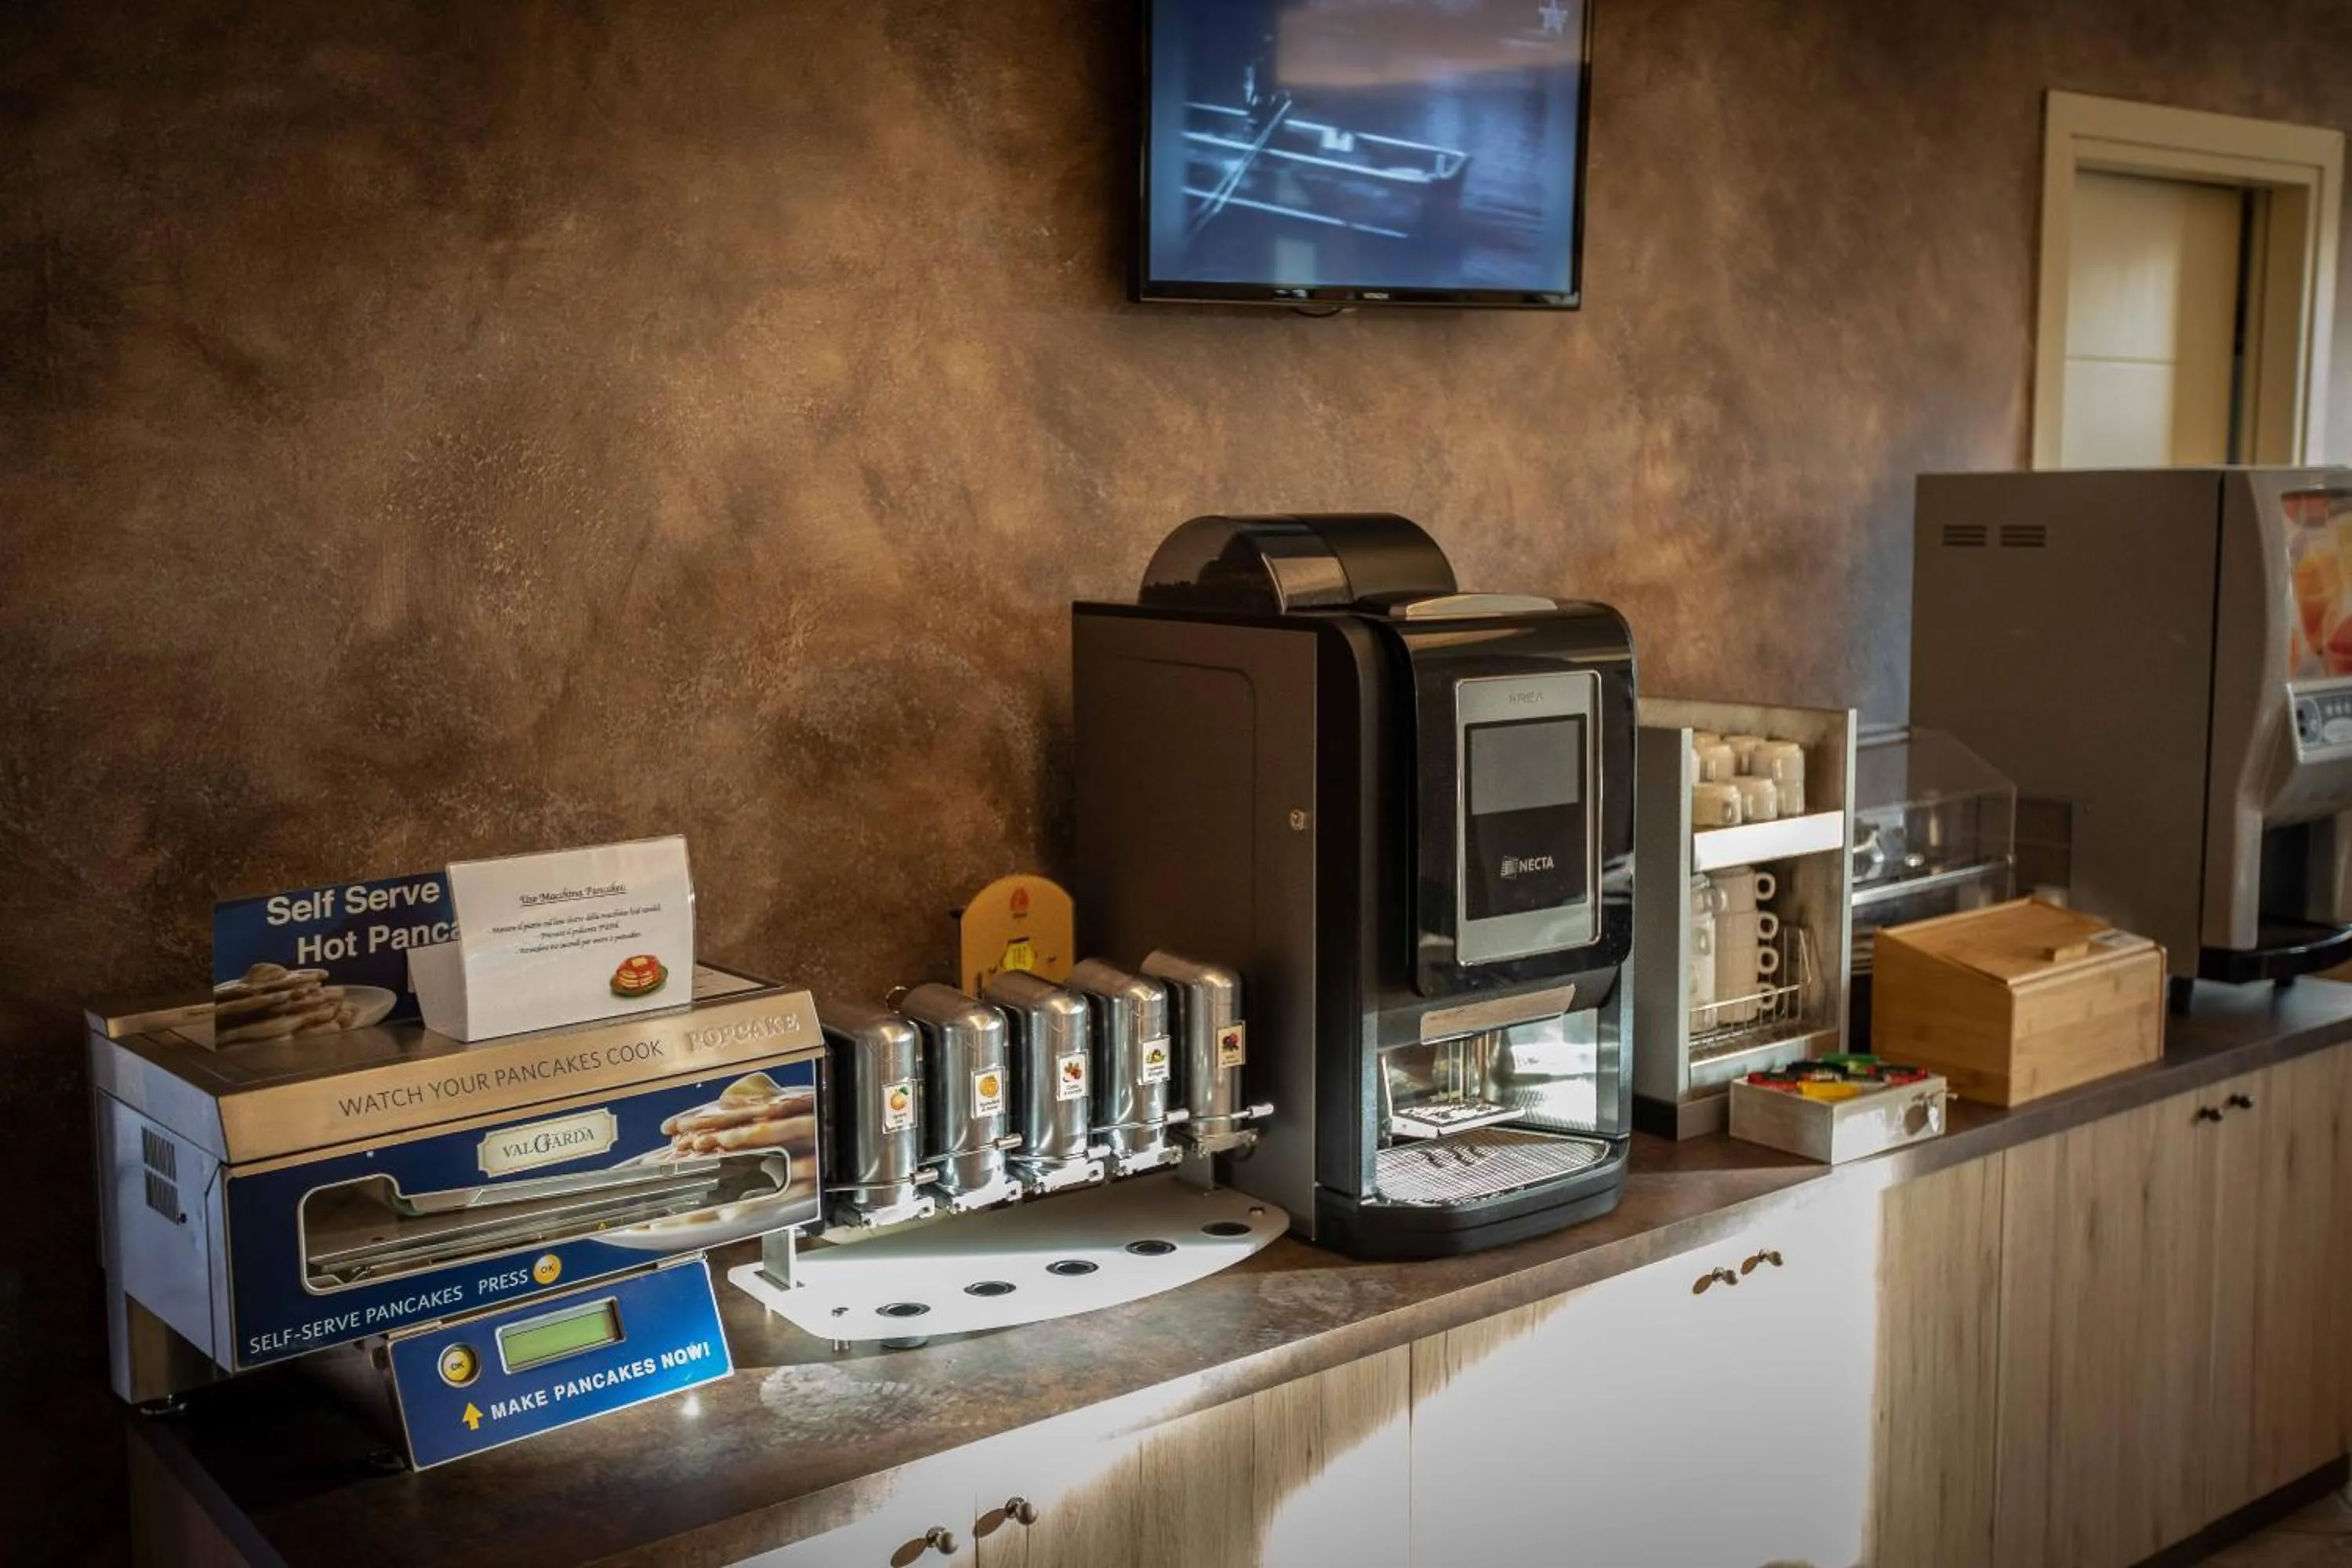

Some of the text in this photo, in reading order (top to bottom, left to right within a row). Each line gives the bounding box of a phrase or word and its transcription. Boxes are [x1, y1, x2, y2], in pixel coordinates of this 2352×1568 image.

[1519, 855, 1555, 873] NECTA
[267, 880, 441, 926] Self Serve
[296, 931, 358, 965] Hot
[684, 1012, 800, 1051] POPCAKE
[339, 1039, 665, 1118] WATCH YOUR PANCAKES COOK
[249, 1264, 555, 1355] SELF-SERVE PANCAKES PRESS OK
[451, 1360, 465, 1370] OK
[490, 1341, 711, 1420] MAKE PANCAKES NOW!
